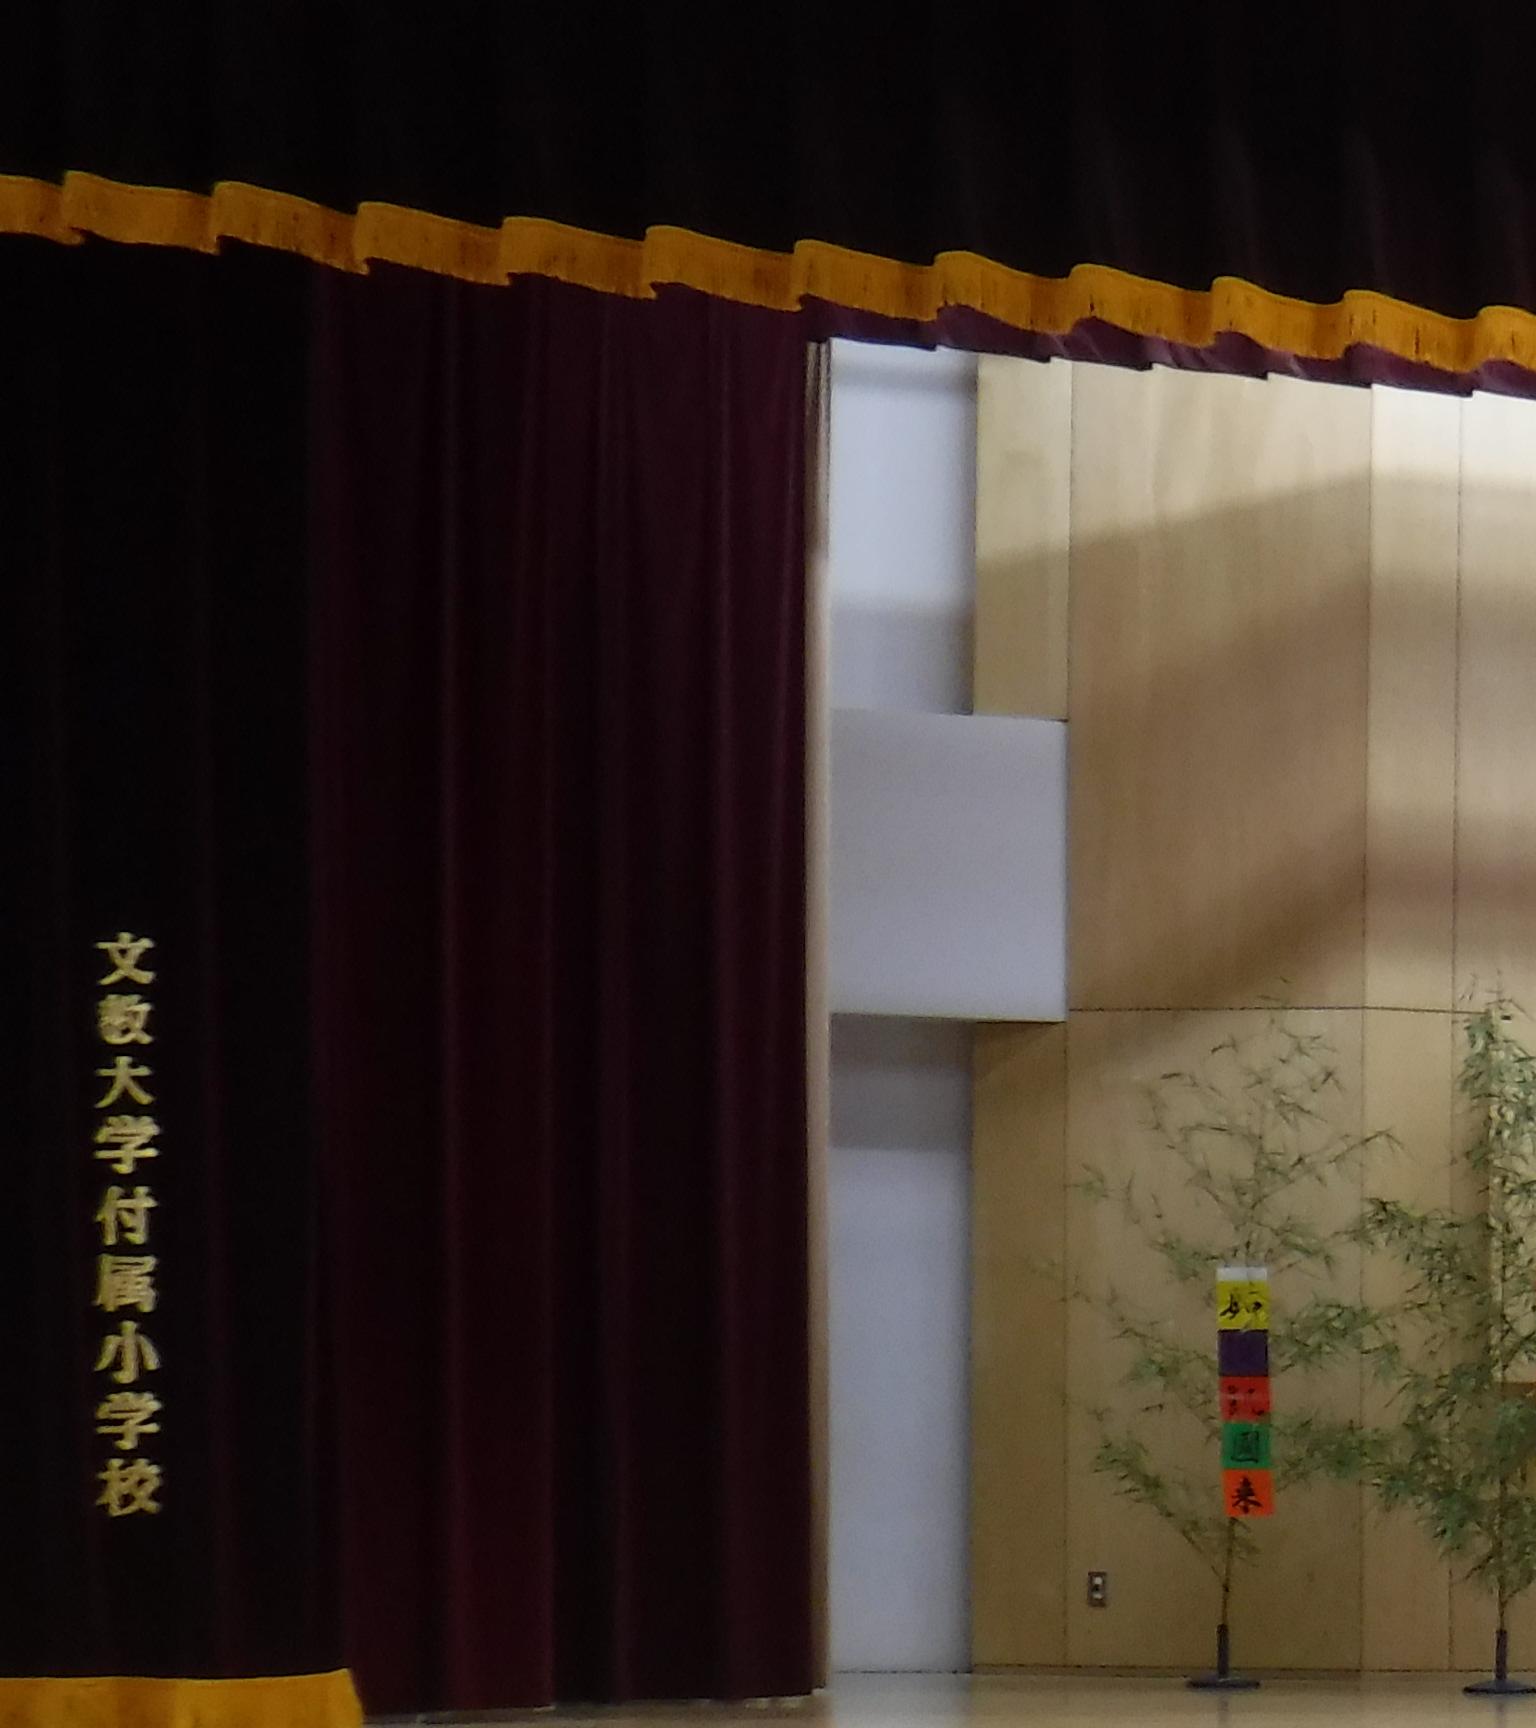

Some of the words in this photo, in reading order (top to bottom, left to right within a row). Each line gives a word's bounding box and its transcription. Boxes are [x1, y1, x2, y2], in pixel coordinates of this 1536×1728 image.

[94, 932, 162, 1518] 文教大学付属小学校
